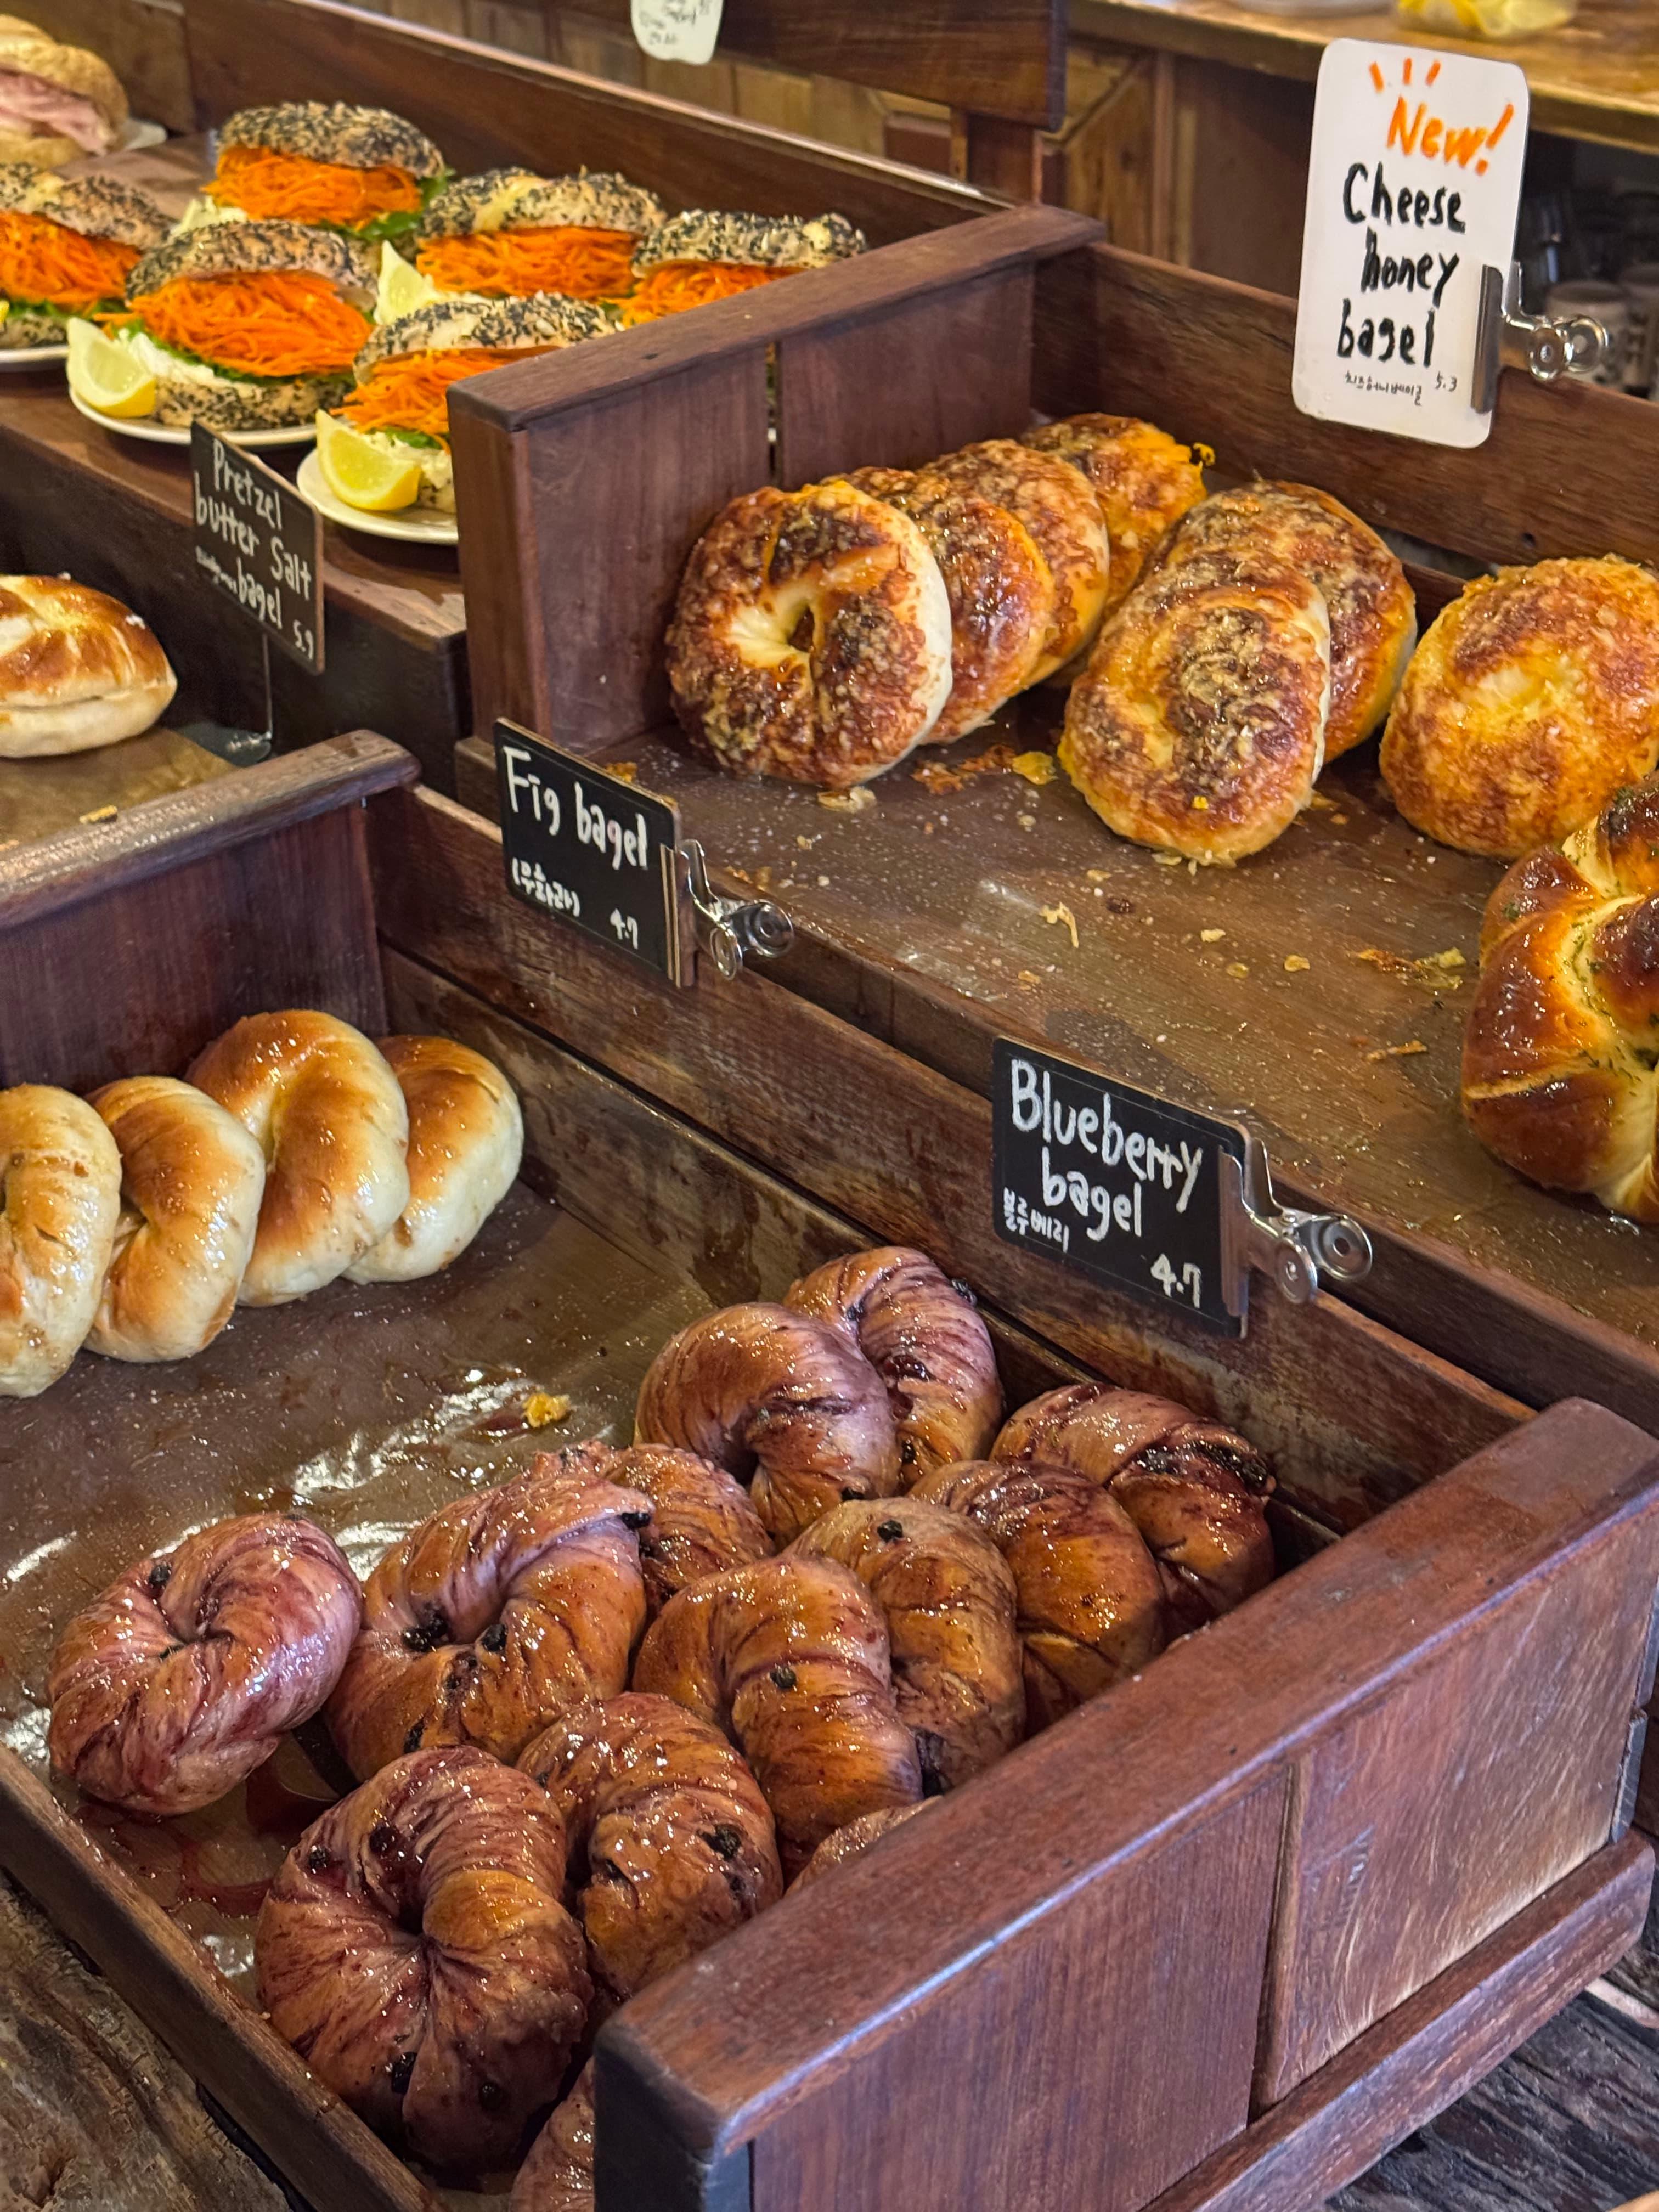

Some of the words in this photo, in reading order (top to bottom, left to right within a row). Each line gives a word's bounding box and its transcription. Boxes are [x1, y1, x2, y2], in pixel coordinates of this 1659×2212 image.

[1387, 96, 1514, 174] New!
[1343, 161, 1465, 234] Cheese
[1361, 227, 1459, 309] honey
[1337, 298, 1436, 368] bagel
[1435, 371, 1458, 392] 5.3
[194, 470, 260, 557] butter
[212, 438, 283, 531] Pretzel
[236, 557, 283, 630] bagel
[503, 746, 561, 837] Fig
[574, 781, 648, 871] bagel
[610, 909, 638, 949] 4.7
[1011, 1058, 1204, 1214] Blueberry
[1003, 1187, 1070, 1253] 블루베리
[1042, 1146, 1142, 1242] bagel
[1150, 1254, 1201, 1308] 4.7
